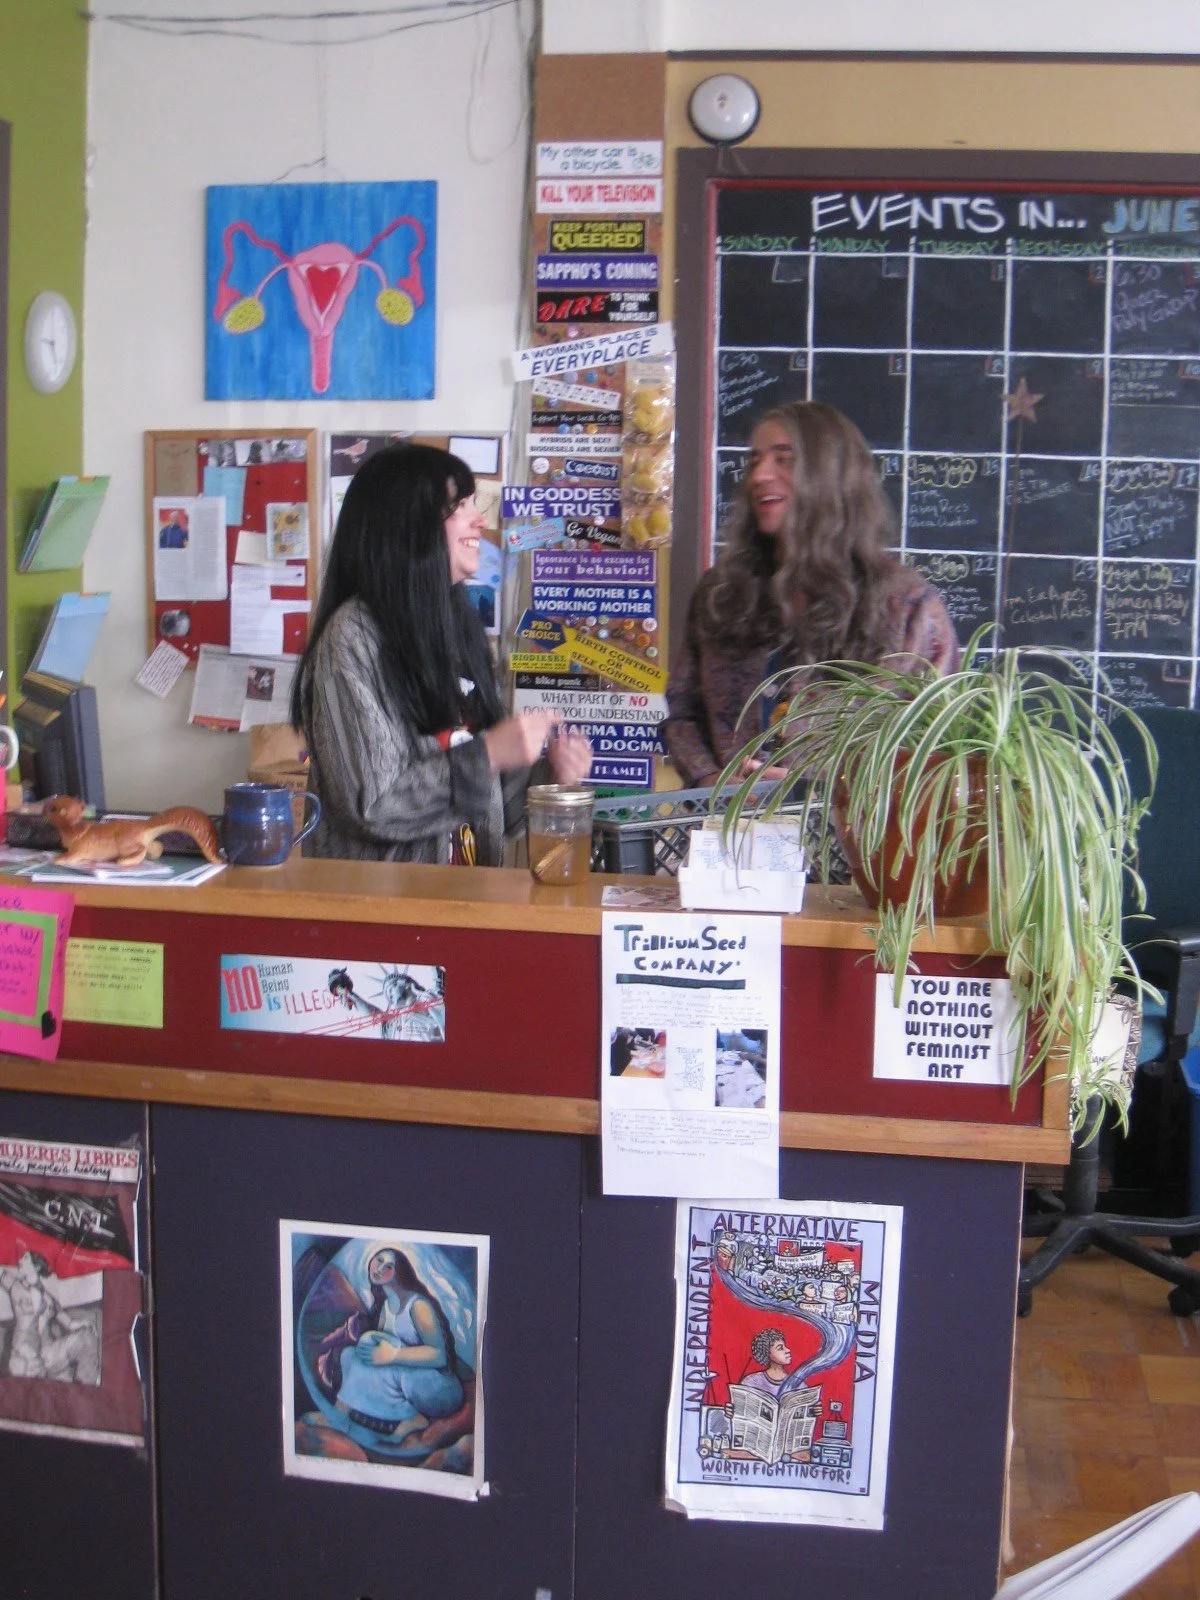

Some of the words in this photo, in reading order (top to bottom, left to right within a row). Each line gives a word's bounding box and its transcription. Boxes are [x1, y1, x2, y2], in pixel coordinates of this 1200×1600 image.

[540, 146, 558, 161] My
[563, 146, 596, 157] other
[601, 147, 623, 157] car
[627, 146, 638, 157] is
[560, 160, 569, 170] a
[541, 185, 562, 203] KILL
[567, 185, 594, 203] YOUR
[597, 184, 657, 203] TELEVISION
[811, 193, 1005, 233] EVENTS
[1018, 200, 1087, 229] IN...
[1102, 199, 1200, 234] JUNE
[552, 222, 582, 233] KEEP
[584, 222, 643, 233] PORTLAND
[537, 262, 600, 280] SAPPHO'S
[606, 262, 657, 280] COMING
[538, 293, 609, 322] DARE
[610, 293, 621, 302] TO
[623, 293, 650, 302] THINK
[620, 302, 639, 311] FOR
[521, 353, 529, 361] A
[532, 340, 595, 359] WOMAN'S
[600, 331, 640, 345] PLACE
[645, 327, 658, 336] IS
[531, 340, 651, 377] EVERYPLACE
[504, 487, 525, 501] IN
[530, 487, 621, 501] GODDESS
[512, 503, 545, 517] WE
[550, 503, 615, 517] TRUST
[566, 522, 585, 537] Go
[536, 555, 577, 567] Ignorance
[580, 555, 588, 563] is
[636, 555, 650, 564] for
[975, 557, 996, 572] 22
[536, 565, 570, 577] your
[576, 564, 650, 576] behavior!
[534, 587, 570, 597] EVERY
[574, 587, 625, 599] MOTHER
[628, 588, 640, 598] IS
[642, 588, 652, 599] A
[534, 601, 597, 612] WORKING
[600, 602, 651, 613] MOTHER
[531, 620, 552, 630] PRO
[521, 631, 560, 641] CHOICE
[574, 634, 607, 655] BIRTH
[608, 647, 662, 679] CONTROL
[607, 658, 624, 671] OR
[570, 650, 598, 667] SELF
[598, 662, 651, 692] CONTROL
[541, 692, 574, 704] WHAT
[578, 693, 606, 705] PART
[609, 694, 626, 706] OF
[629, 695, 649, 708] NO
[563, 706, 586, 719] YOU
[589, 707, 665, 722] UNDERSTAND
[557, 723, 617, 737] KARMA
[623, 725, 658, 738] RAN
[600, 739, 664, 753] DOGMA
[701, 925, 747, 951] Seed
[257, 962, 293, 978] Human
[261, 978, 290, 994] Being
[911, 979, 950, 996] YOU
[956, 981, 992, 998] ARE
[267, 994, 282, 1012] is
[907, 1000, 993, 1018] NOTHING
[905, 1021, 993, 1039] WITHOUT
[906, 1042, 991, 1059] FEMINIST
[927, 1063, 964, 1079] ART
[76, 1150, 138, 1168] LIBRES
[74, 1162, 111, 1181] history
[713, 1212, 861, 1242] ALTERNATIVE
[685, 1233, 714, 1412] INDEPENDENT
[854, 1280, 880, 1384] MEDIA
[701, 1458, 750, 1476] WORTH
[753, 1461, 820, 1479] FIGHTING
[821, 1467, 851, 1485] FOR!
